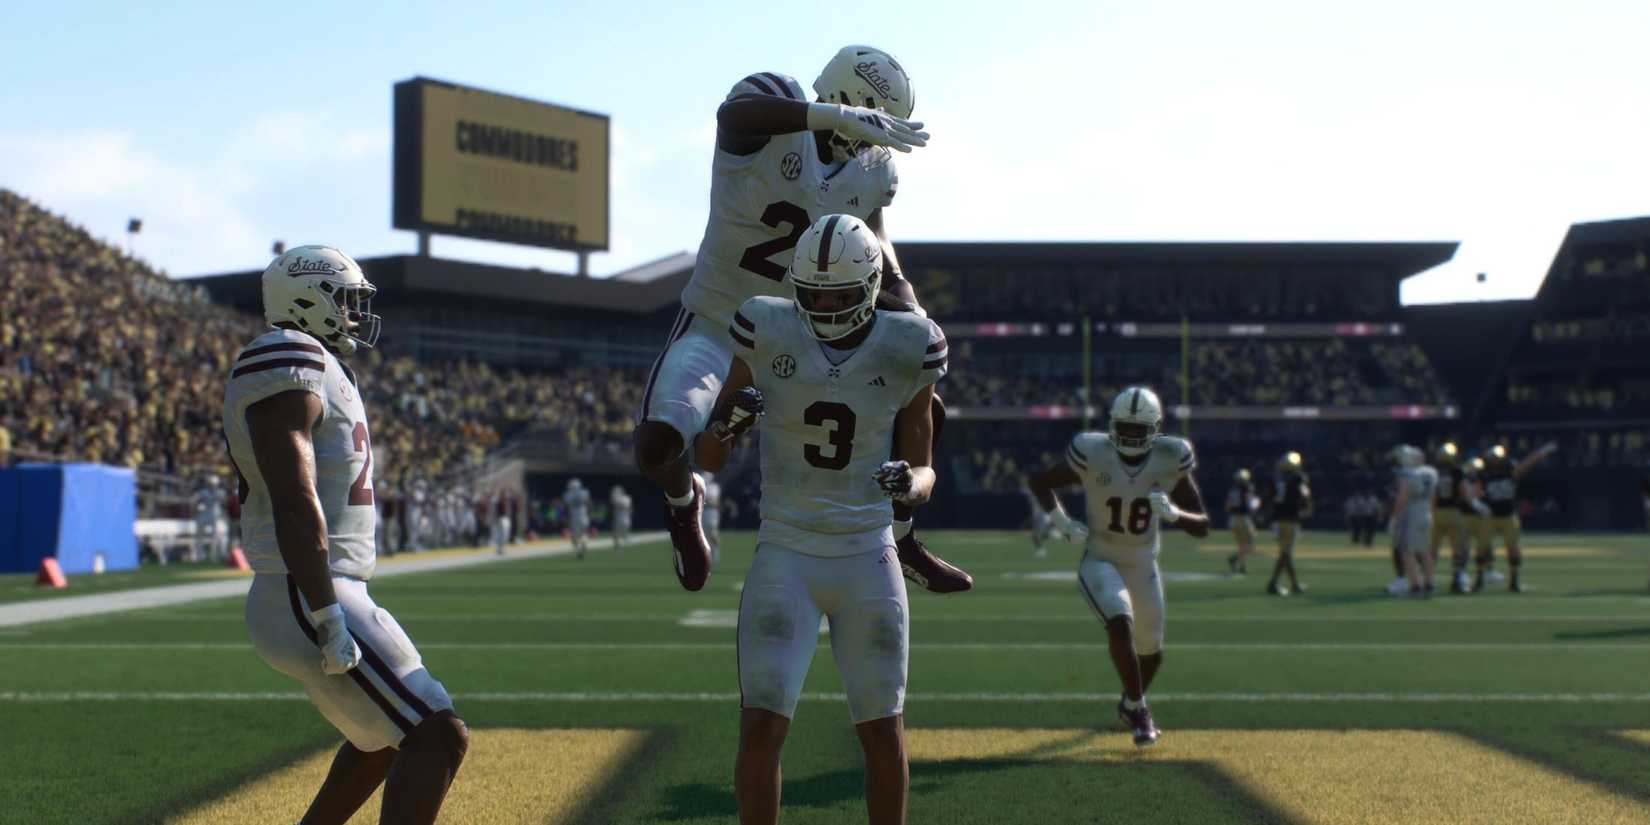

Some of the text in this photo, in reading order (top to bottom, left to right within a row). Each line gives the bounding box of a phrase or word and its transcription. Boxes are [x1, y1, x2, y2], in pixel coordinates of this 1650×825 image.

[854, 62, 891, 99] State
[455, 119, 578, 172] COMMODORES
[781, 152, 802, 180] SEC
[739, 200, 811, 282] 2
[288, 256, 338, 278] State
[772, 354, 796, 378] SEC
[804, 401, 857, 470] 3
[1106, 496, 1152, 535] 18
